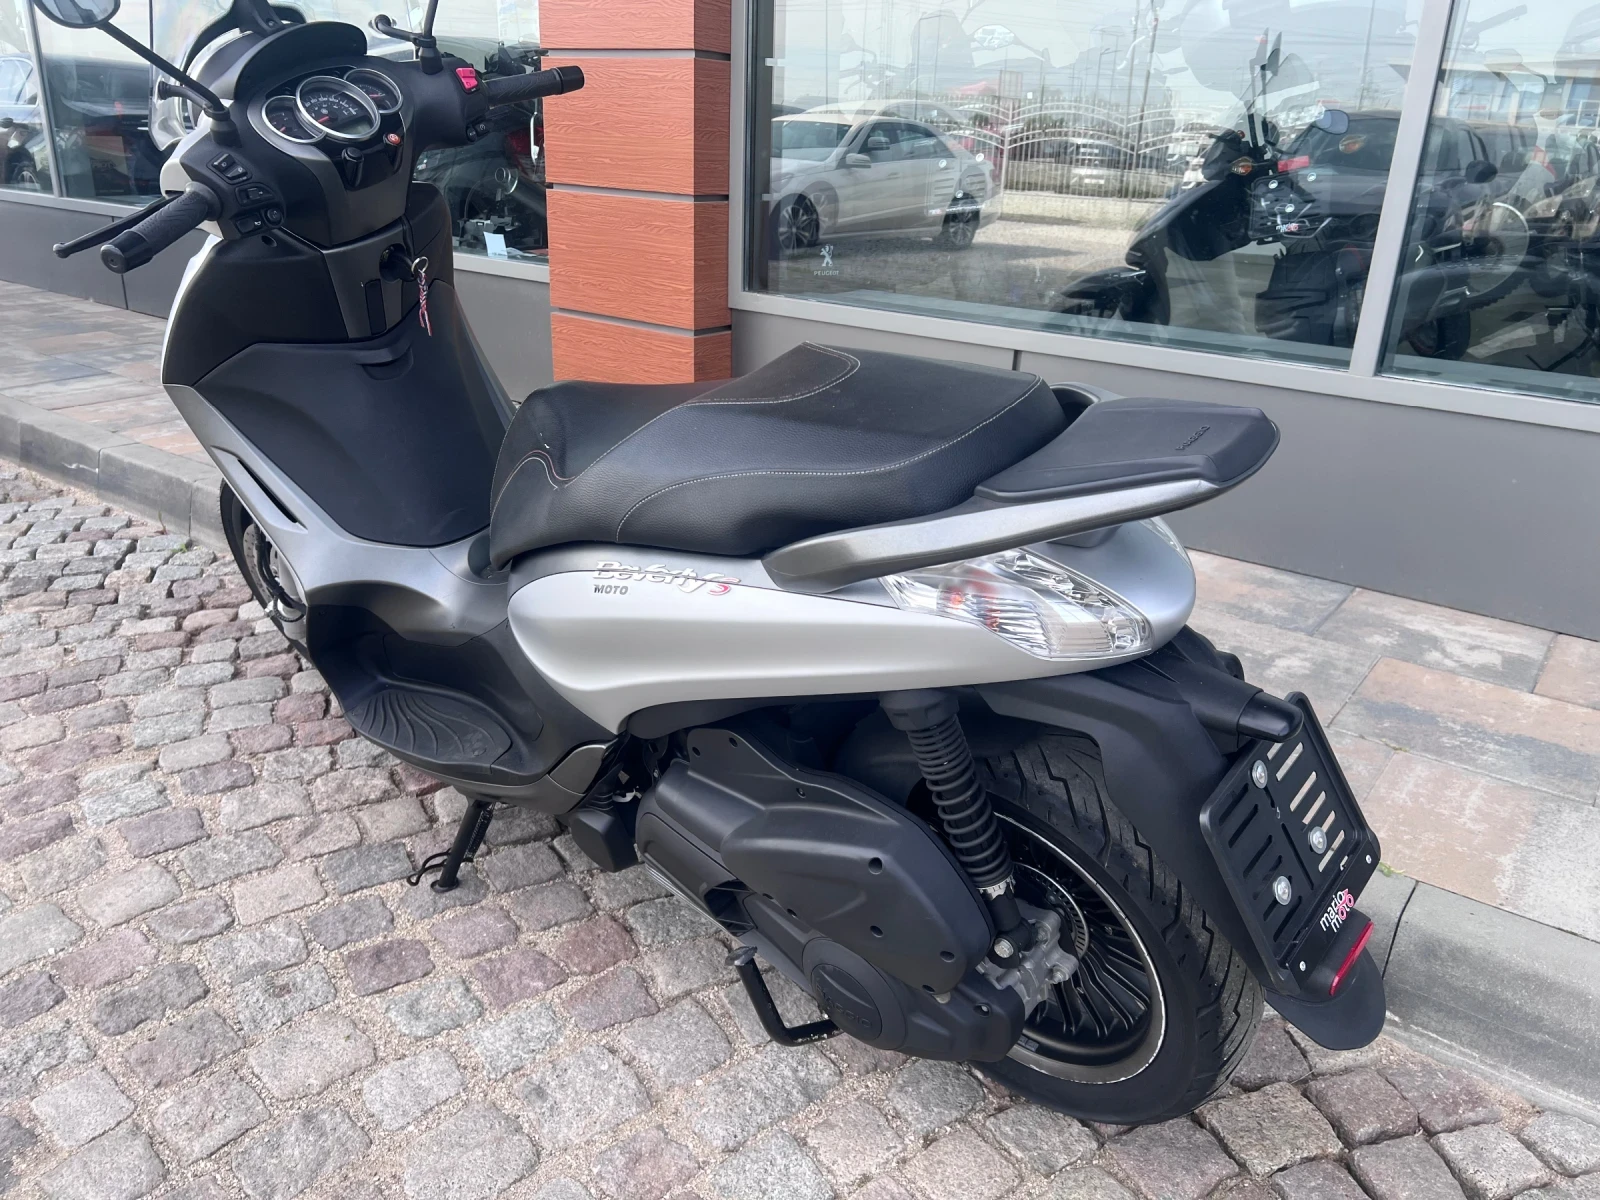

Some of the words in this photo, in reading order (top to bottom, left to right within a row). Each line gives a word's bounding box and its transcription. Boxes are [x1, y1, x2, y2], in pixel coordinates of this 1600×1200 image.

[593, 584, 629, 595] MOTO
[1319, 890, 1345, 931] mario
[1330, 893, 1354, 932] moto
